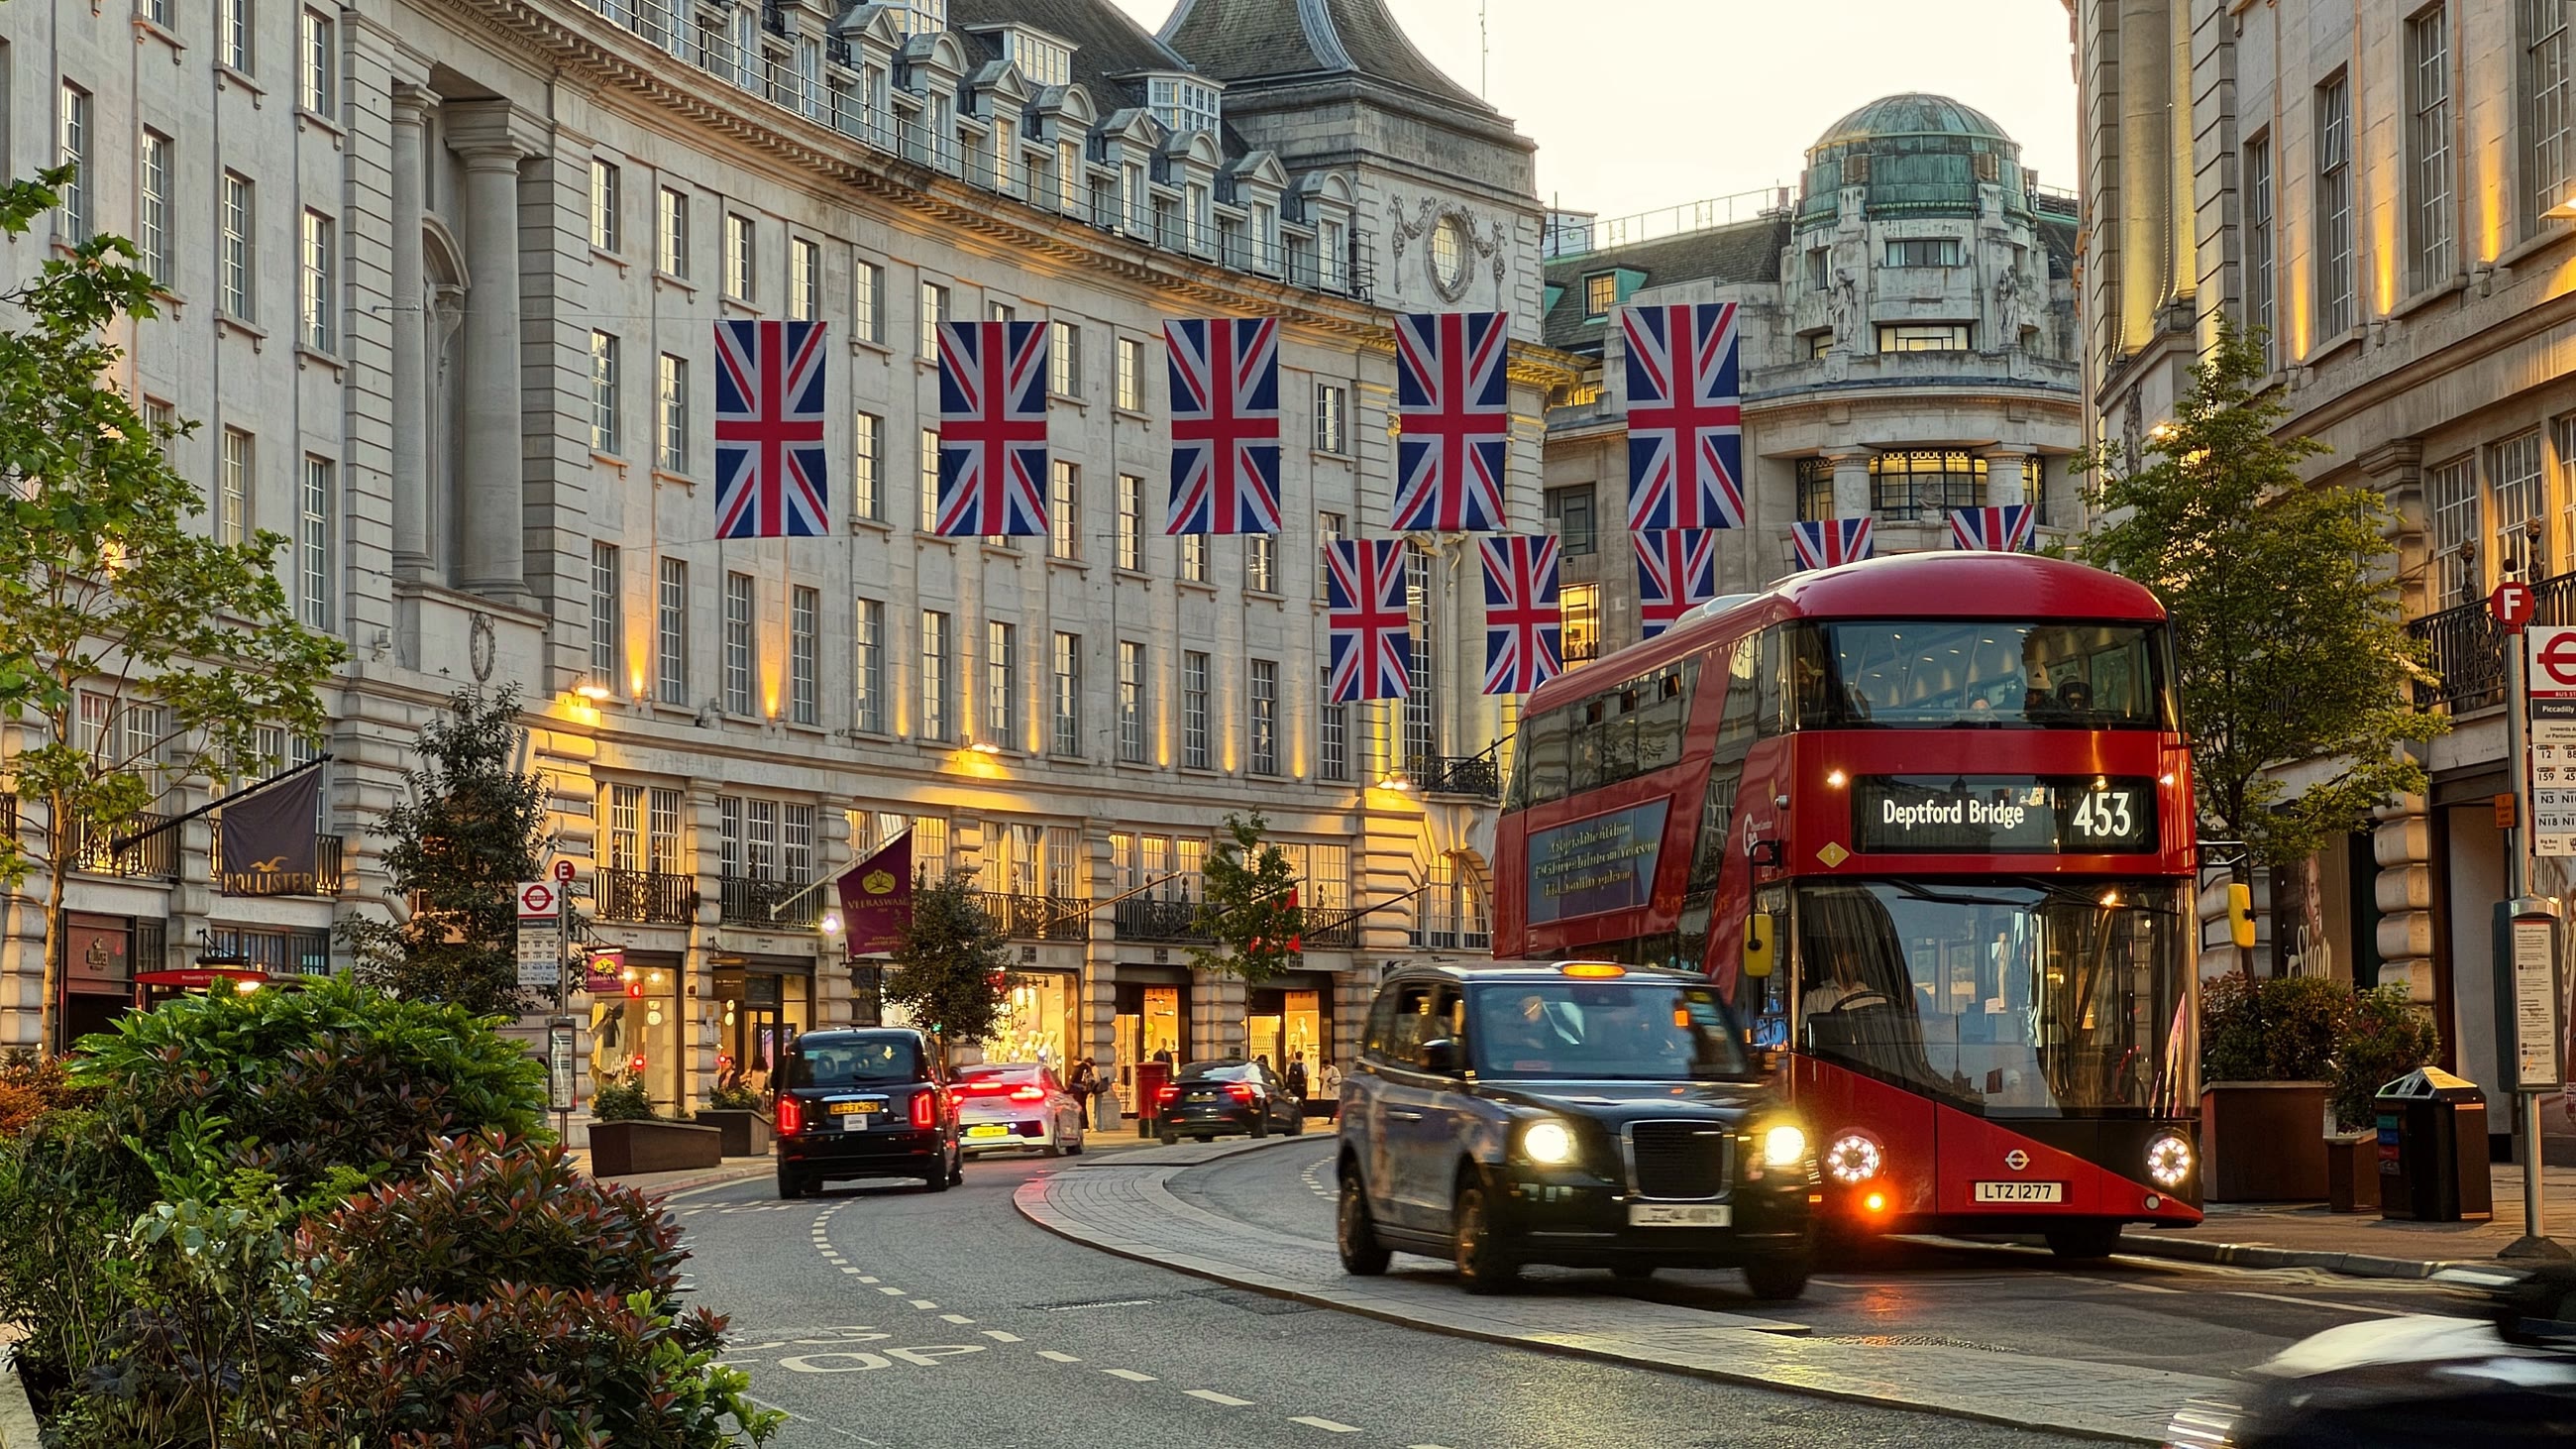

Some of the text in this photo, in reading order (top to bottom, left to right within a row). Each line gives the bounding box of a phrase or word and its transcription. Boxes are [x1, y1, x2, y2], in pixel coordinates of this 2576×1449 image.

[2504, 589, 2522, 620] F
[2542, 705, 2575, 714] Piccadilly
[2541, 750, 2551, 759] 12
[2564, 772, 2576, 781] 45
[2540, 795, 2554, 804] N3
[1883, 792, 2131, 836] Deptford Bridge 453
[2538, 818, 2558, 827] N18
[559, 863, 570, 879] E
[224, 872, 314, 893] HOLLISTER
[1985, 1184, 2052, 1199] LTZ 1277
